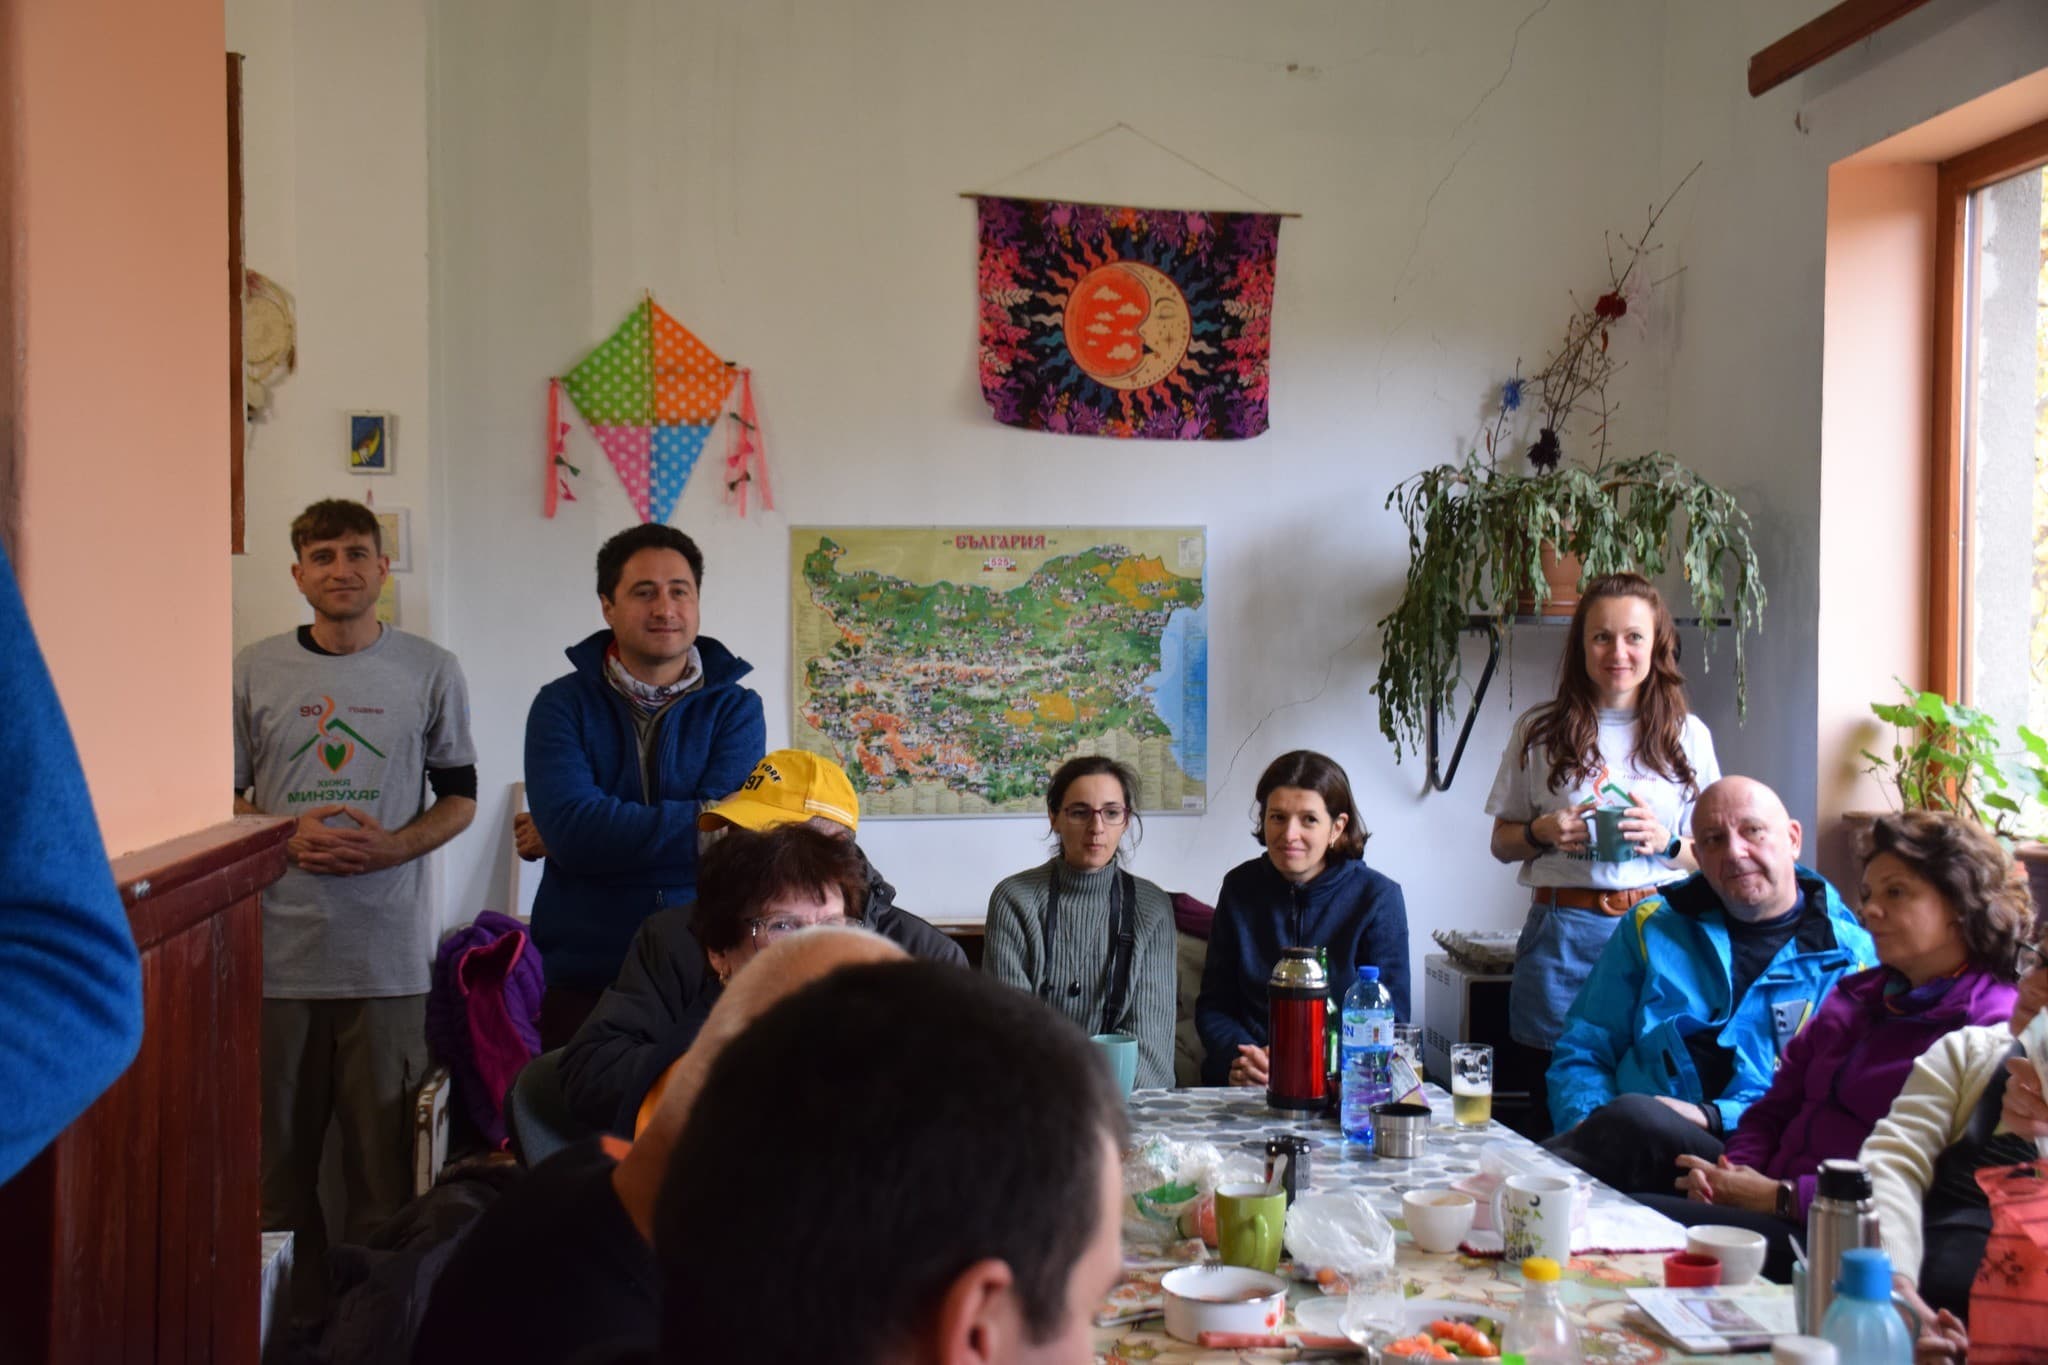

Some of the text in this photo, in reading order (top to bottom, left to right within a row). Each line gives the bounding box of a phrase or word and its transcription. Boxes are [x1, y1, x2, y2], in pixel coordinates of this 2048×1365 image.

[955, 535, 1046, 550] БЪЛГАРИЯ
[300, 704, 323, 717] 90
[761, 763, 782, 782] YORK
[287, 789, 381, 804] МИНЗУХАР
